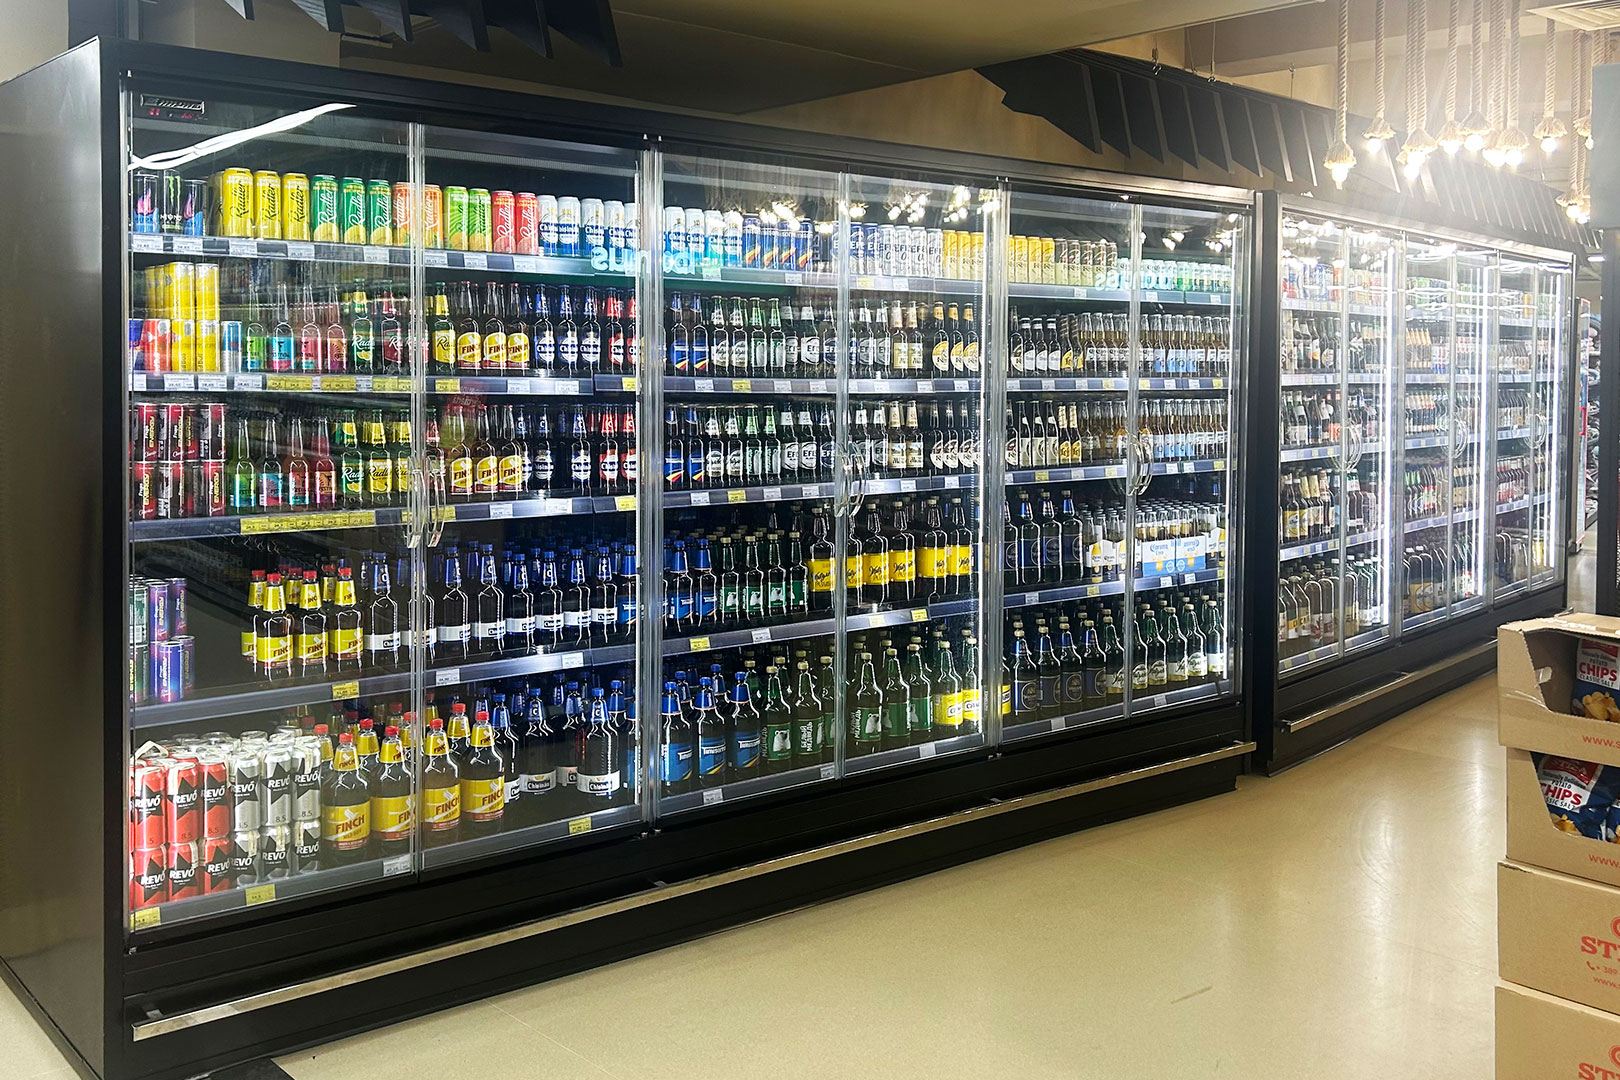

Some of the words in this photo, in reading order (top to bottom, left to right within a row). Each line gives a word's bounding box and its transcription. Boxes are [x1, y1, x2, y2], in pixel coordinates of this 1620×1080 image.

[318, 189, 336, 224] Radler
[349, 191, 365, 226] Radler
[374, 192, 391, 227] Radler
[497, 202, 515, 237] Radler
[1579, 662, 1617, 682] CHIPS
[1552, 779, 1572, 790] POTATO
[301, 809, 313, 818] 8.5
[435, 796, 460, 815] FINCH
[275, 815, 286, 823] 8.5
[335, 814, 365, 834] FINCH
[1581, 936, 1620, 961] ST
